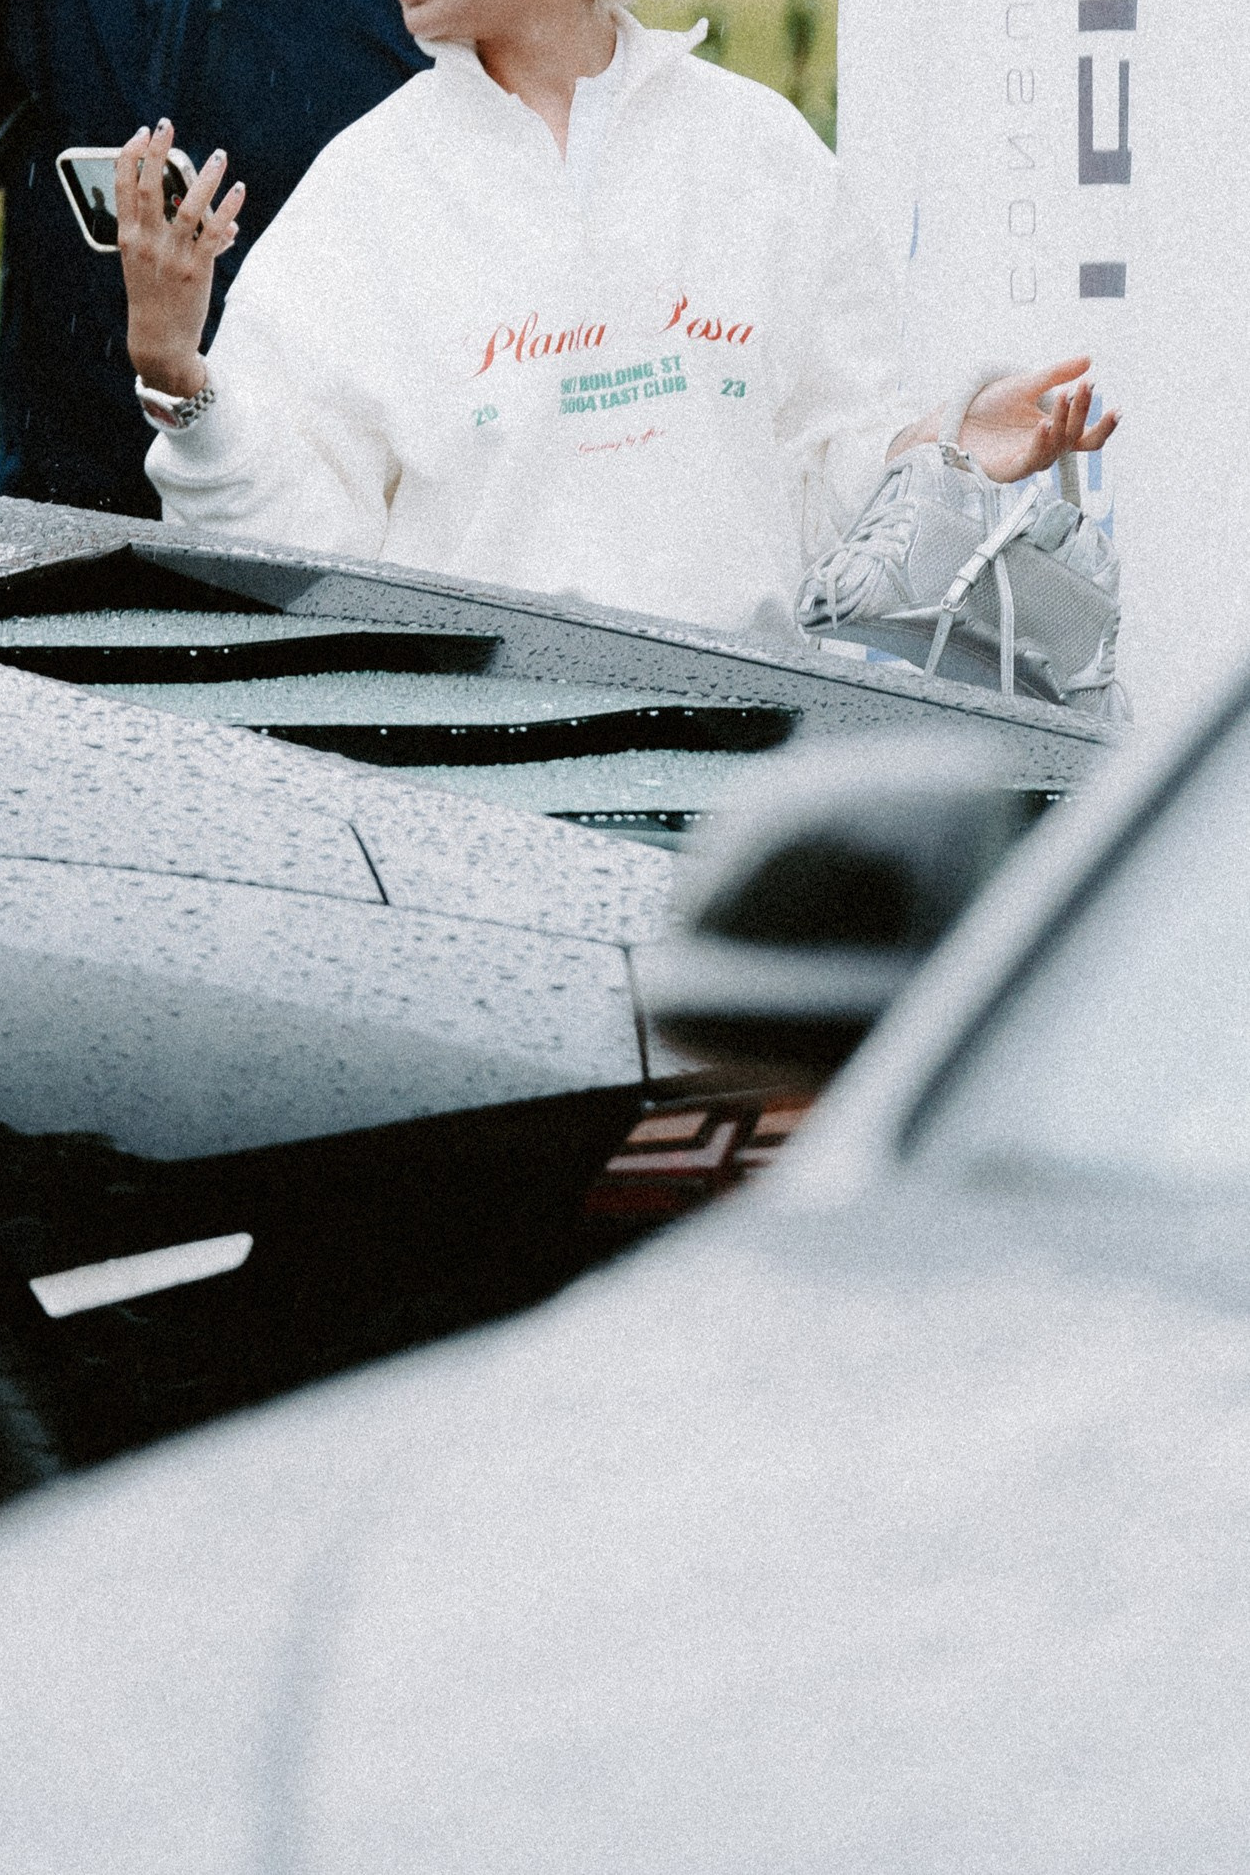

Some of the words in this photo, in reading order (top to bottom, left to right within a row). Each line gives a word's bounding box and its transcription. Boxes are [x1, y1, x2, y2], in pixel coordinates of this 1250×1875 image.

[470, 311, 607, 378] Planta
[661, 355, 681, 373] ST
[600, 385, 638, 409] EAST
[644, 375, 687, 398] CLUB
[720, 378, 747, 398] 23
